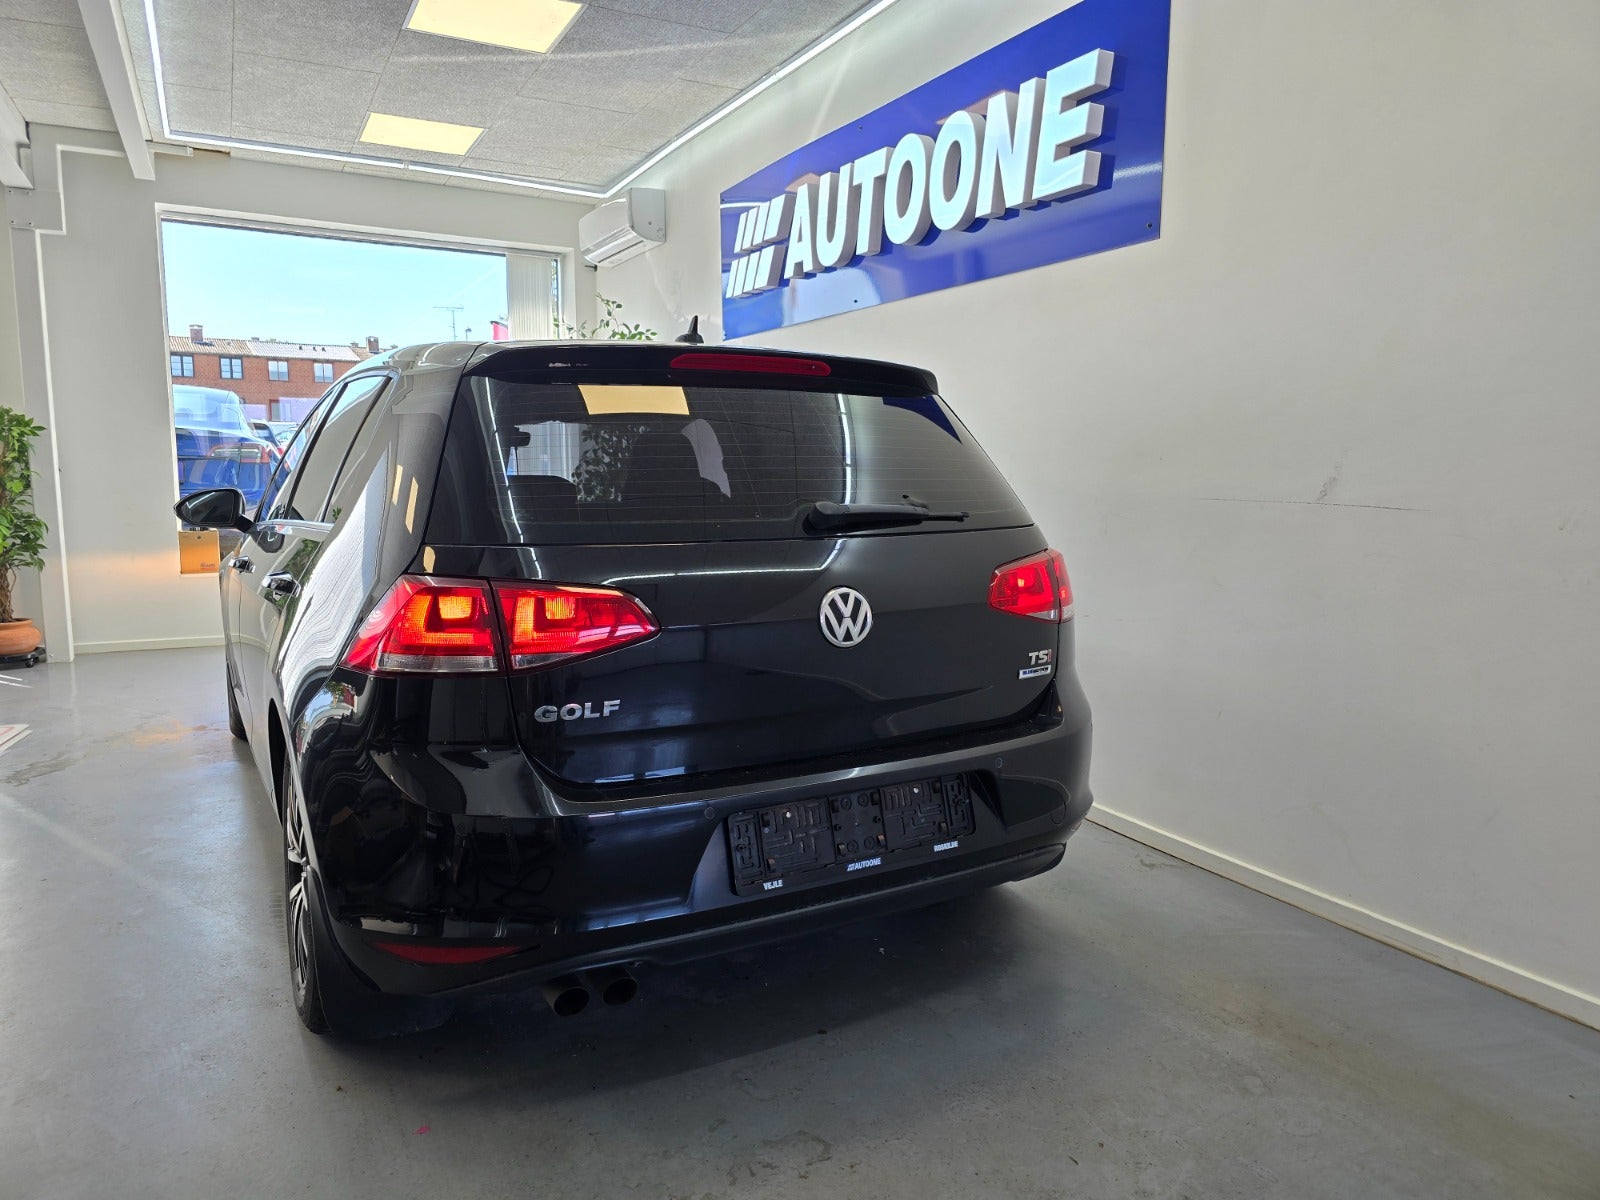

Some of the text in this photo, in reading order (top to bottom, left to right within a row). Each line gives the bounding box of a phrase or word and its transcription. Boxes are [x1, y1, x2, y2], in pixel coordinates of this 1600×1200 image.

[784, 48, 1115, 279] AUTOONE
[534, 700, 621, 722] GOLF
[763, 879, 783, 890] VEJLE
[854, 857, 881, 870] AUTOONE
